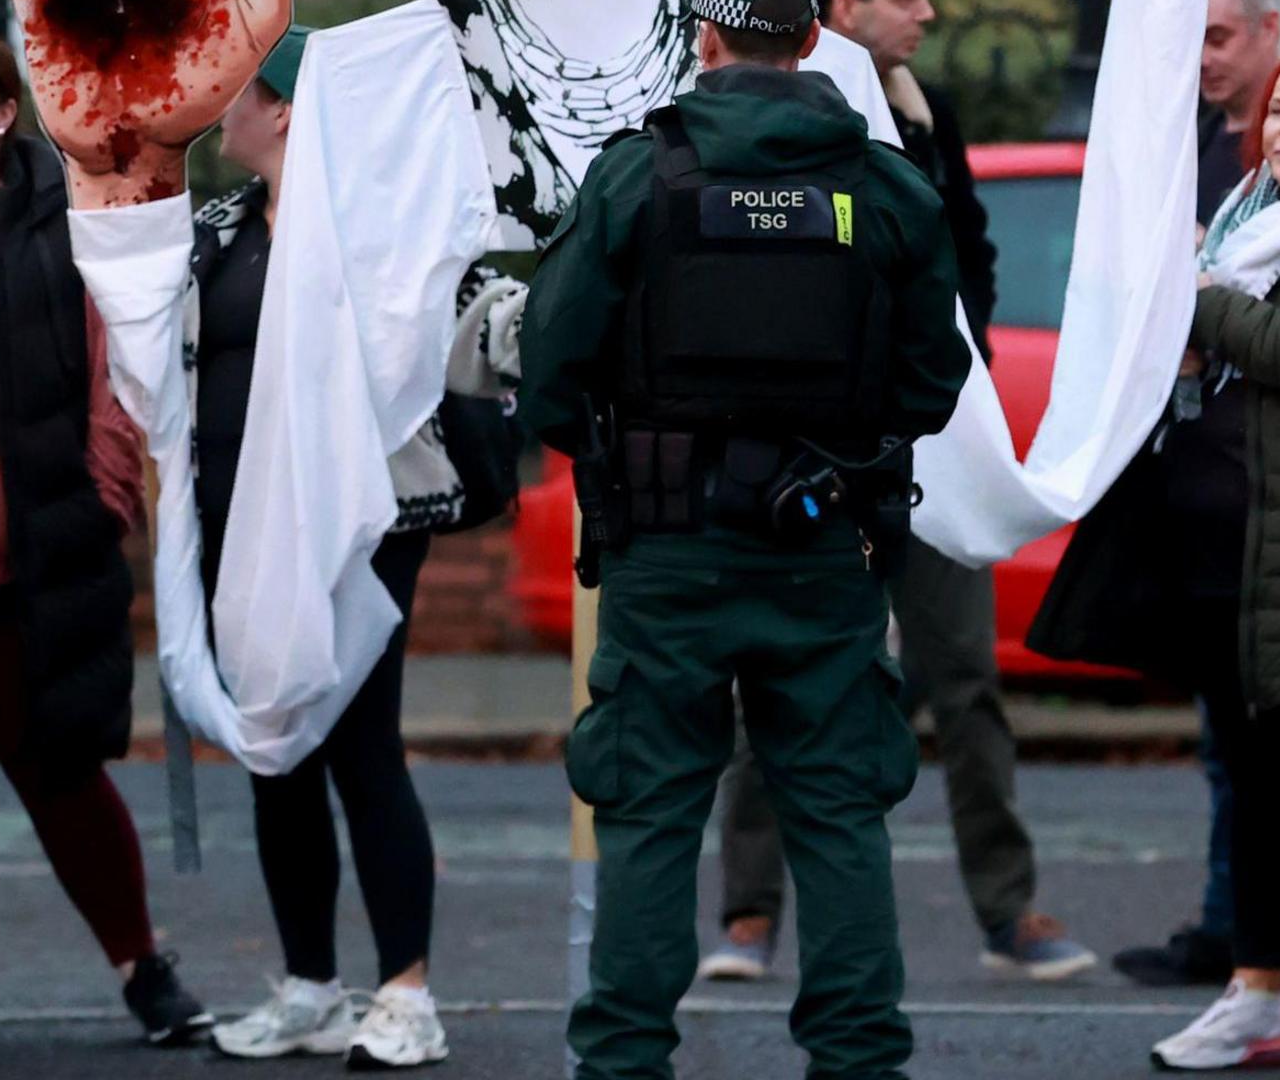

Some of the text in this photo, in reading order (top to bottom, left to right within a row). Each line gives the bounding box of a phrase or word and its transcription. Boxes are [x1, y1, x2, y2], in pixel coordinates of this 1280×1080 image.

[749, 16, 797, 34] POLICE
[731, 191, 805, 207] POLICE
[747, 213, 788, 229] TSG
